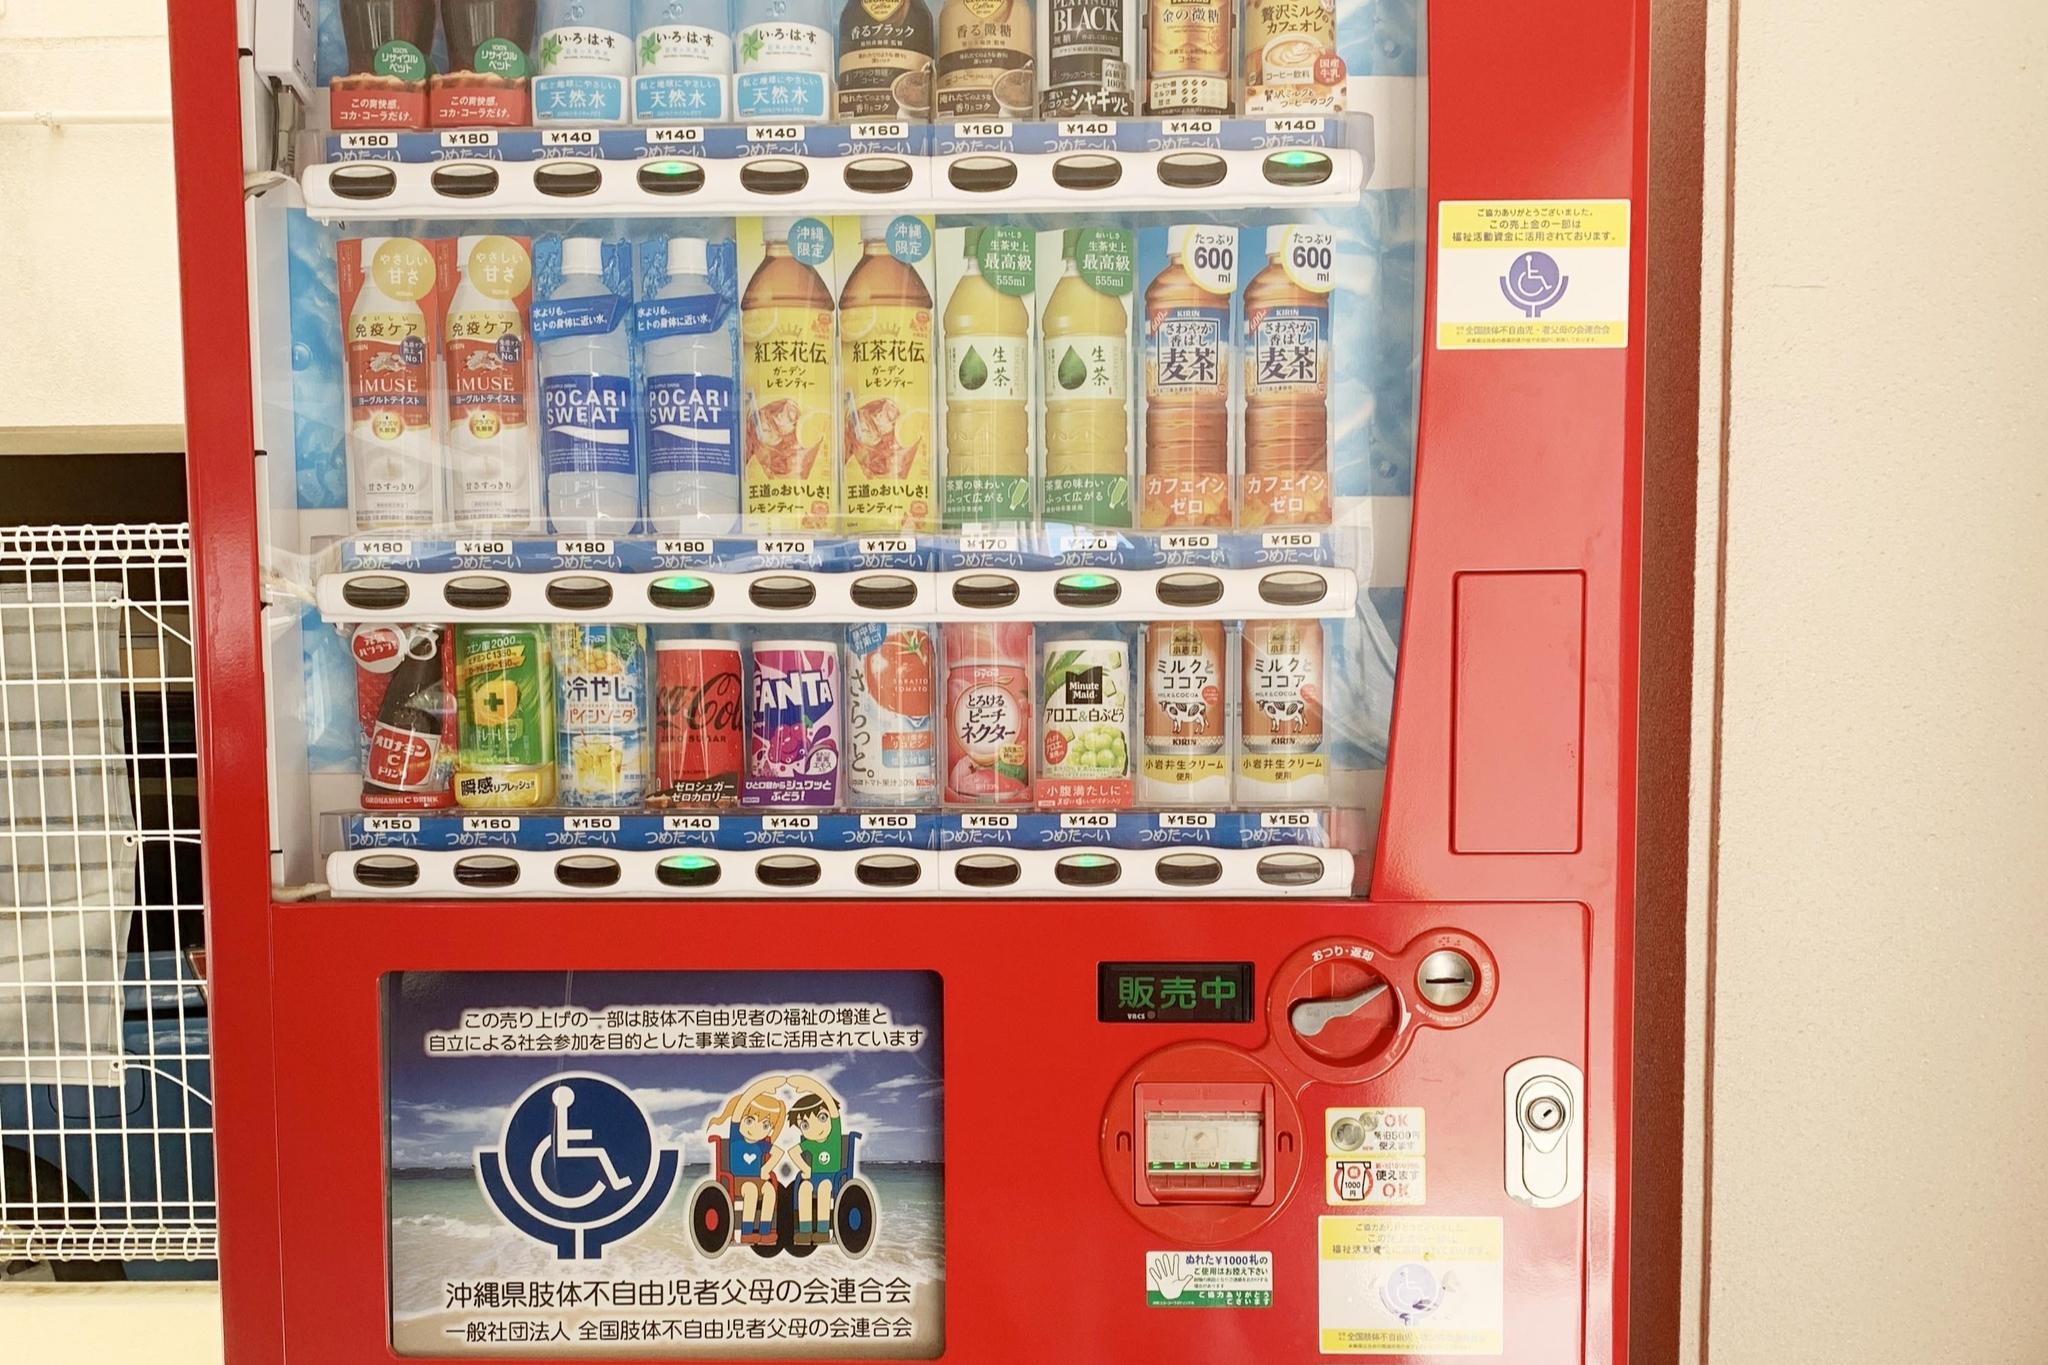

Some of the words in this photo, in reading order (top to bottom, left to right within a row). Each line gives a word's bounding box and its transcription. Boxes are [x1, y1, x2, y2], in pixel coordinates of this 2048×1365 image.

[1053, 6, 1122, 34] BLACK
[1163, 8, 1219, 23] 金の微糖
[1262, 4, 1328, 24] 贅沢ミルクの
[851, 24, 915, 40] 香るブラック
[956, 23, 1012, 39] 香る微糖
[1267, 20, 1323, 35] カフェオレ
[1266, 70, 1310, 80] コーヒー飲料
[550, 89, 606, 109] 天然水
[650, 89, 706, 108] 天然水
[752, 86, 809, 105] 天然水
[859, 125, 900, 136] ¥160
[963, 124, 1004, 135] ¥160
[1067, 123, 1108, 134] ¥140
[1171, 122, 1212, 132] ¥140
[1275, 120, 1316, 130] ¥140
[448, 133, 490, 145] ¥180
[551, 132, 592, 143] ¥140
[655, 129, 696, 141] ¥140
[756, 128, 797, 138] ¥140
[349, 135, 389, 147] ¥180
[1477, 208, 1593, 217] ご協力ありがとうございました。
[1489, 219, 1581, 229] この売上金の一部は
[796, 225, 825, 242] 沖縄
[894, 223, 922, 239] 沖縄
[1452, 231, 1616, 242] 福祉活動資金に活用されております。
[1195, 233, 1234, 245] たっぷり
[1293, 233, 1332, 245] たっぷり
[796, 243, 825, 258] 限定
[895, 240, 922, 256] 限定
[990, 240, 1030, 253] 生茶史上
[1088, 241, 1128, 253] 生茶史上
[380, 254, 427, 264] やさしい
[476, 253, 523, 264] やさしい
[984, 252, 1033, 271] 最高級
[1083, 253, 1131, 272] 最高級
[1194, 246, 1233, 271] 600
[1293, 246, 1332, 270] 600
[387, 267, 419, 286] 甘さ
[483, 266, 515, 284] 甘さ
[996, 275, 1026, 287] 555ml
[1095, 275, 1124, 287] 555ml
[1177, 309, 1201, 317] KIRIN
[1276, 308, 1300, 316] KIRIN
[355, 323, 417, 338] 免疫ケア
[452, 321, 514, 336] 免疫ケア
[1165, 322, 1213, 335] さわやか
[1265, 322, 1311, 335] さわやか
[1170, 335, 1208, 347] 香ばし
[1270, 334, 1307, 346] 香ばし
[754, 341, 828, 364] 紅茶花伝
[852, 340, 926, 363] 紅茶花伝
[992, 346, 1011, 388] 生茶
[1091, 345, 1110, 387] 生茶
[1160, 347, 1216, 381] 麦茶
[1260, 346, 1315, 380] 麦茶
[772, 365, 806, 376] ガーデン
[871, 364, 905, 375] ガーデン
[359, 375, 418, 393] iMUSE
[456, 373, 514, 391] iMUSE
[766, 378, 815, 388] レモンティー
[865, 377, 914, 388] レモンティー
[546, 389, 626, 407] POCARI
[649, 389, 728, 407] POCARI
[547, 406, 620, 425] SWEAT
[649, 406, 722, 425] SWEAT
[368, 482, 416, 493] 甘さすっきり
[465, 481, 512, 491] 甘さすっきり
[1148, 477, 1224, 495] カフェイン
[1247, 475, 1325, 494] カフェイン
[947, 491, 1004, 504] ふって広がる
[1046, 490, 1103, 503] ふって広がる
[749, 502, 805, 513] レモンティー
[847, 501, 903, 513] レモンティー
[1170, 497, 1203, 516] ゼロ
[1270, 496, 1303, 514] ゼロ
[867, 540, 907, 552] ¥170
[1169, 537, 1209, 547] ¥150
[1272, 535, 1312, 545] ¥150
[364, 542, 403, 552] ¥180
[464, 542, 504, 553] ¥180
[565, 542, 605, 553] ¥180
[665, 541, 705, 553] ¥180
[765, 542, 805, 553] ¥170
[1157, 658, 1214, 674] ミルクと
[1255, 658, 1312, 674] ミルクと
[1069, 681, 1099, 691] Minute
[1163, 675, 1208, 689] ココア
[1261, 674, 1305, 689] ココア
[567, 676, 633, 703] 冷やし
[753, 671, 833, 713] FANTA
[1072, 690, 1096, 700] Maid
[968, 694, 1005, 707] とろける
[968, 708, 1006, 724] ピーチ
[850, 669, 875, 778] さらっと。
[961, 723, 1016, 745] ネクター
[376, 735, 427, 759] オロナミン
[1172, 738, 1197, 746] KIRIN
[1271, 737, 1296, 745] KIRIN
[1145, 759, 1224, 770] 小岩井生クリーム
[1242, 758, 1322, 770] 小岩井生クリーム
[675, 781, 735, 792] ゼロシュガー
[1046, 785, 1120, 797] 小腹満たしに
[365, 796, 404, 804] ORONAMIN
[413, 795, 439, 804] DRINK
[671, 792, 737, 802] ゼロカロリー
[372, 819, 412, 830] ¥150
[471, 819, 511, 829] ¥160
[572, 819, 612, 829] ¥150
[672, 818, 712, 829] ¥140
[771, 817, 811, 828] ¥140
[868, 816, 908, 827] ¥150
[970, 816, 1009, 827] ¥150
[1069, 815, 1109, 826] ¥140
[1168, 815, 1208, 825] ¥150
[1270, 814, 1310, 825] ¥150
[1312, 946, 1375, 963] おつり・返却
[1117, 975, 1237, 1010] 販売中
[465, 1008, 888, 1029] この売り上げの一部は肢体不自由児者の福祉の増進と
[429, 1029, 923, 1053] 自立による社会参加を目的とした事業資金に活用されています
[1344, 1181, 1361, 1189] 1000
[1185, 1254, 1269, 1265] ぬれた¥1000札の
[1193, 1267, 1269, 1276] ご使用はお控え下さい
[446, 1277, 912, 1309] 沖縄県肢体不自由児者父母の会連合会
[446, 1320, 571, 1342] 一般社団法人
[578, 1316, 913, 1341] 全国肢体不自由児者父母の会連合会
